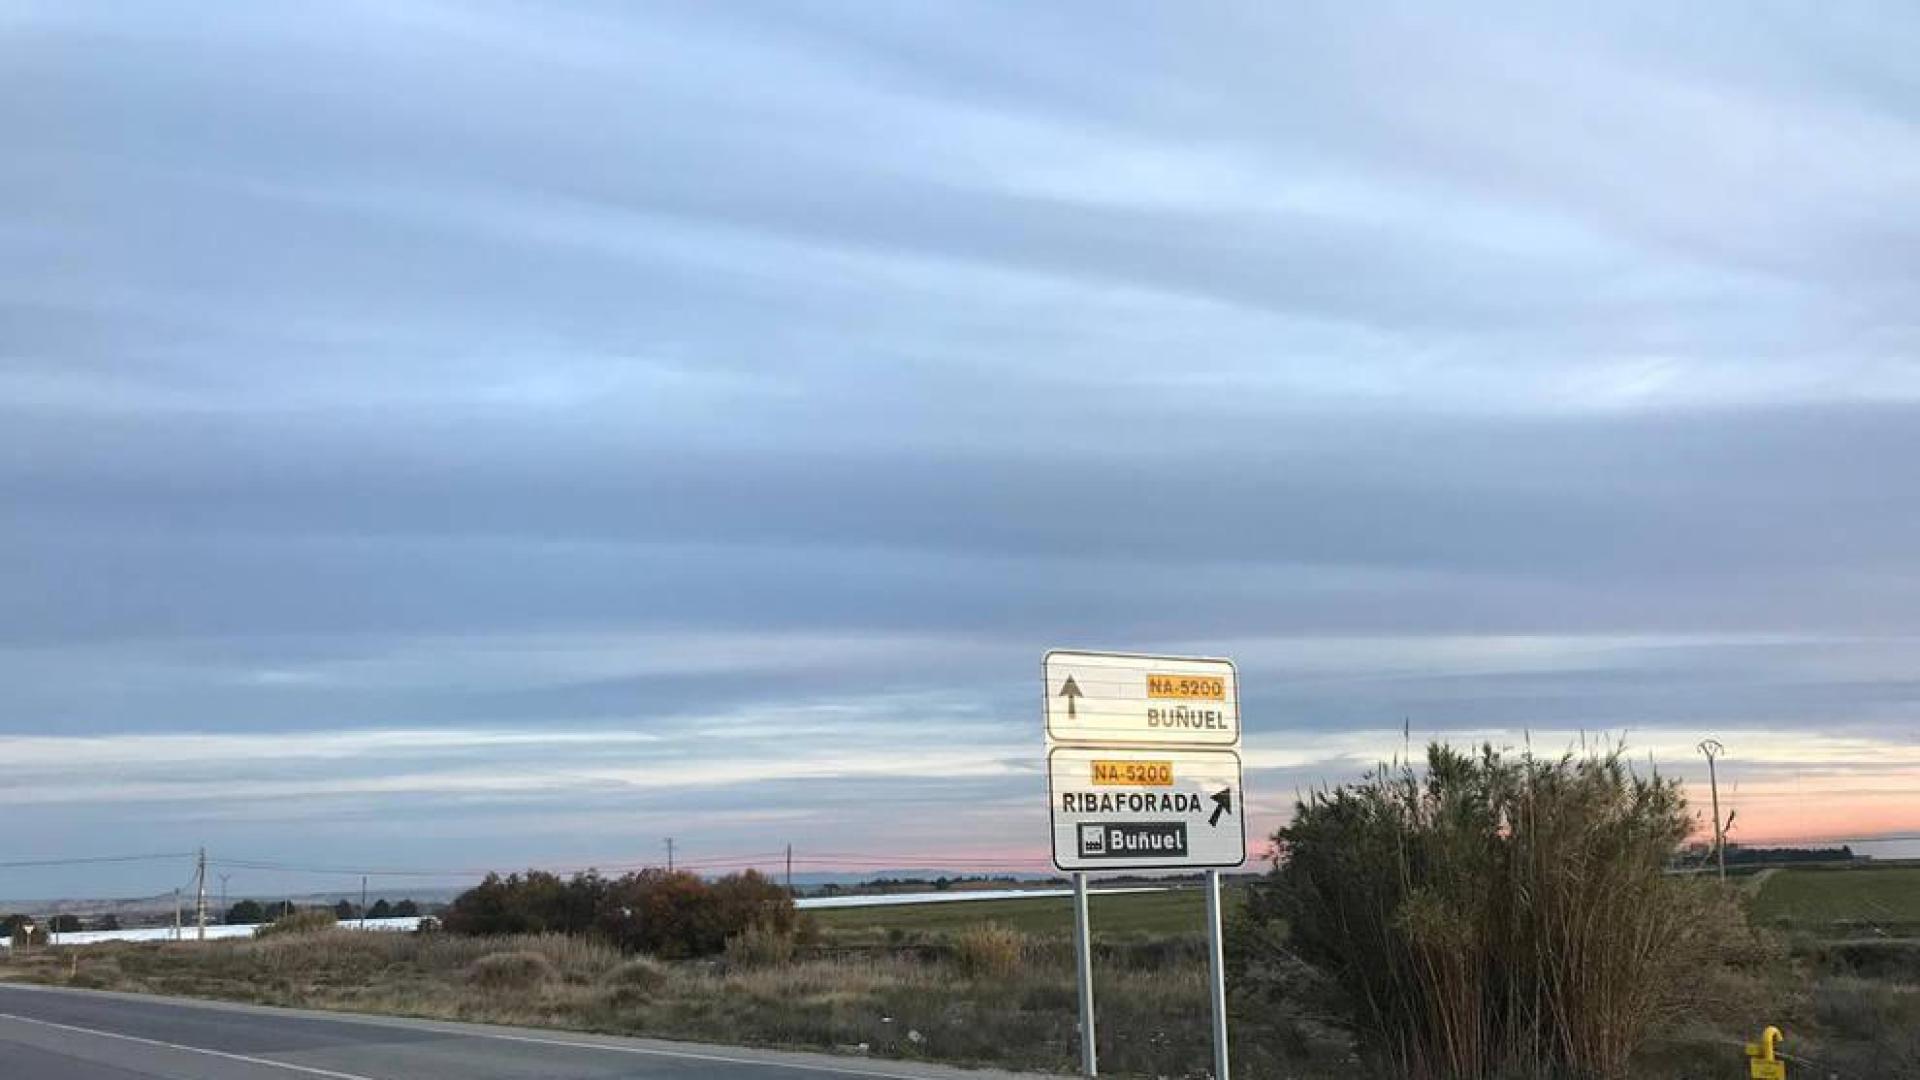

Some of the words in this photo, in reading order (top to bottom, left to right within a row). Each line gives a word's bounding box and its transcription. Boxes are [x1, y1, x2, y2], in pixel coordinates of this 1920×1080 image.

[1149, 676, 1222, 696] NA-5200
[1148, 706, 1228, 729] BUÑUEL
[1094, 764, 1170, 782] NA-5200
[1063, 793, 1202, 812] RIBAFORADA
[1111, 829, 1182, 849] Buñuel
